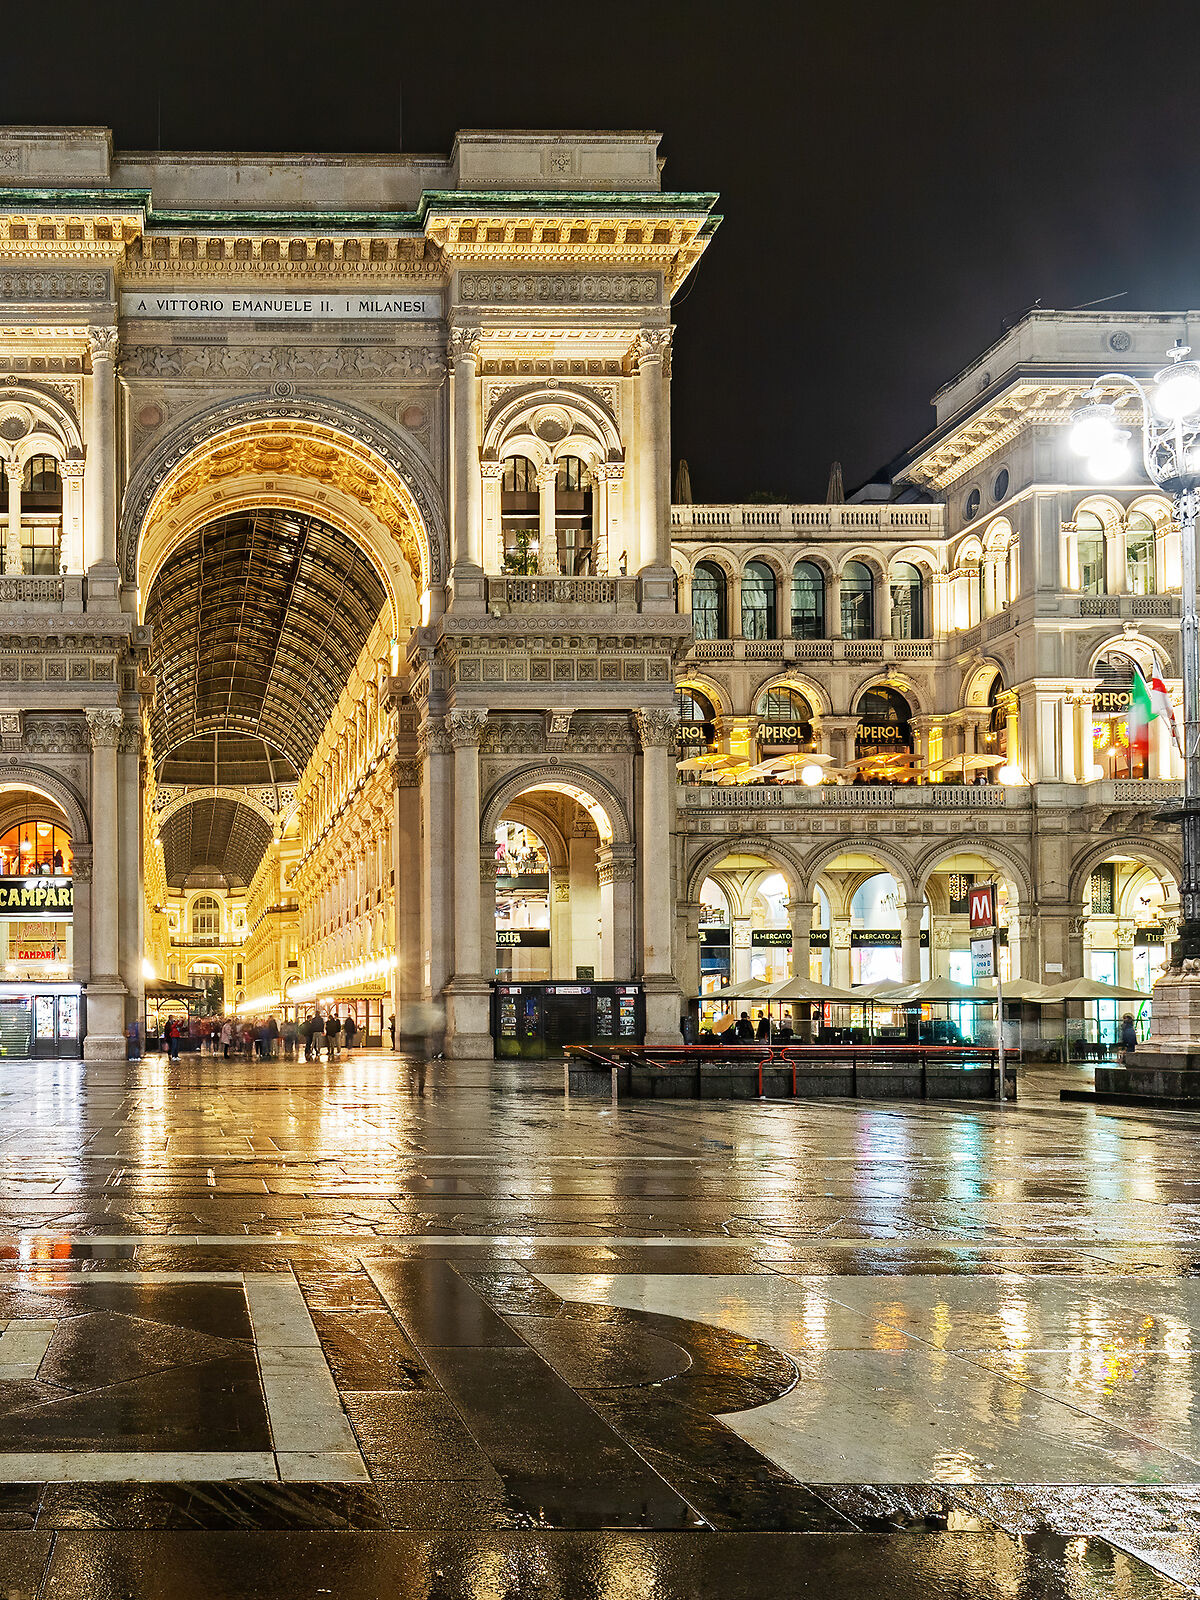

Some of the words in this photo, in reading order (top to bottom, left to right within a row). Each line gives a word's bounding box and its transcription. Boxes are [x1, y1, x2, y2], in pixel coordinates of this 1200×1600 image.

[137, 300, 147, 311] A
[157, 299, 224, 312] VITTORIO
[232, 300, 312, 312] EMANUELE
[320, 300, 334, 312] II.
[345, 300, 350, 312] I
[358, 300, 426, 312] MILANESI
[756, 724, 804, 739] APEROL
[971, 895, 991, 921] M
[18, 950, 56, 960] CAMPARI
